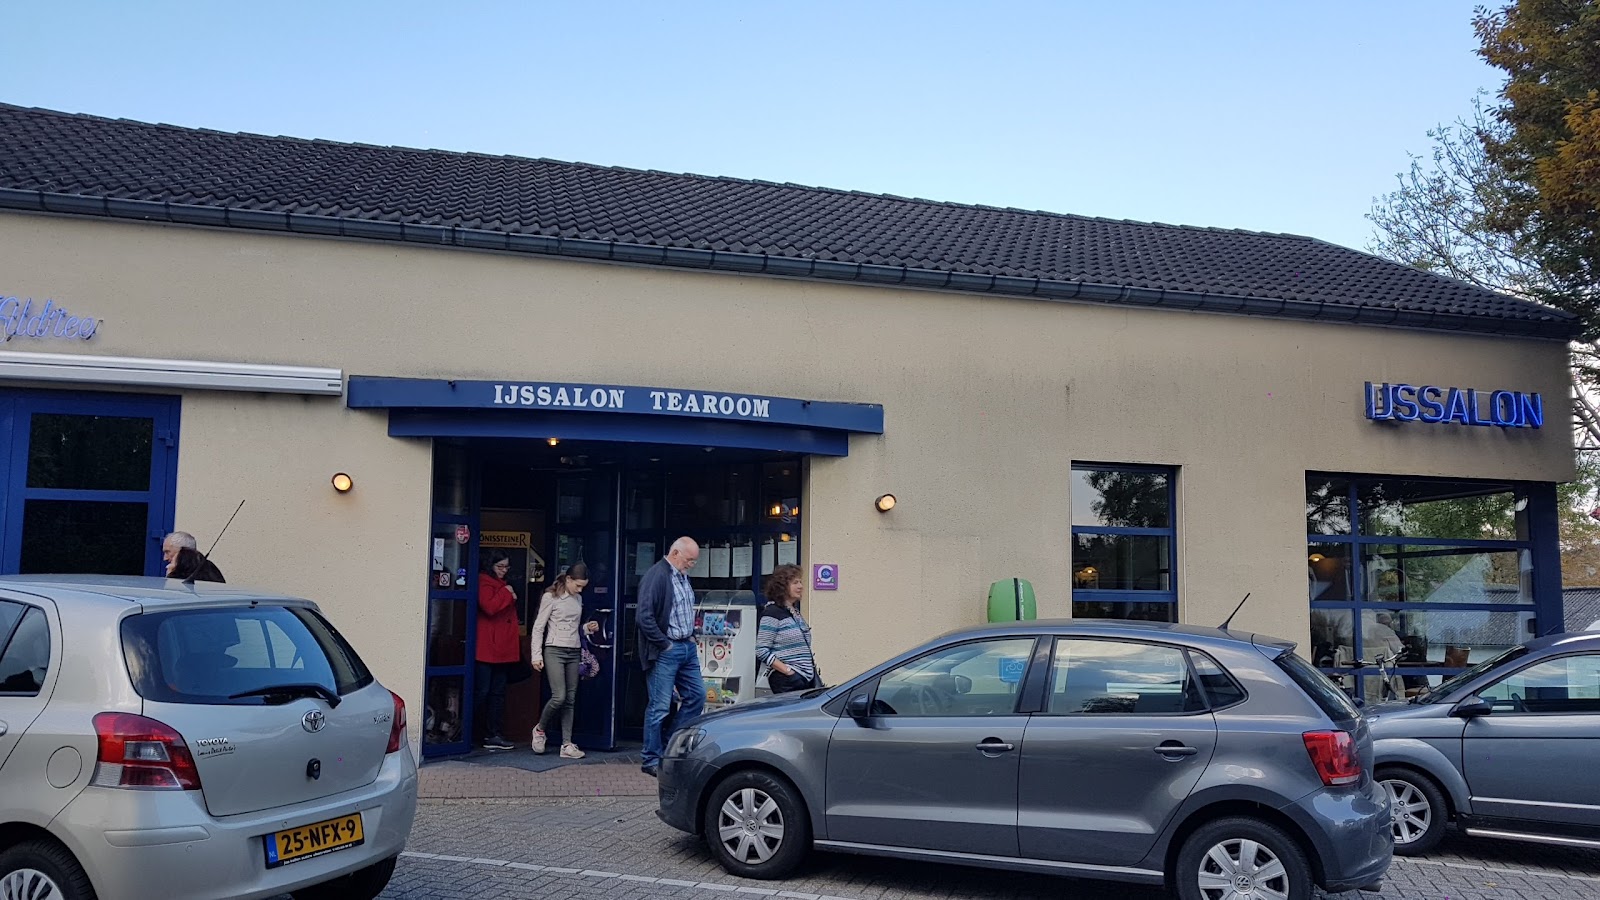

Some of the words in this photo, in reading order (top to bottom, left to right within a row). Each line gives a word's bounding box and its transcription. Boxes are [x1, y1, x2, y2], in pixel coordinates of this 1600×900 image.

[494, 384, 625, 409] IJSSALON
[650, 390, 770, 418] TEAROOM
[1364, 381, 1543, 429] IJSSALON
[196, 737, 228, 747] TOYOTA
[281, 819, 356, 855] 25-NFX-9
[268, 851, 277, 859] NL
